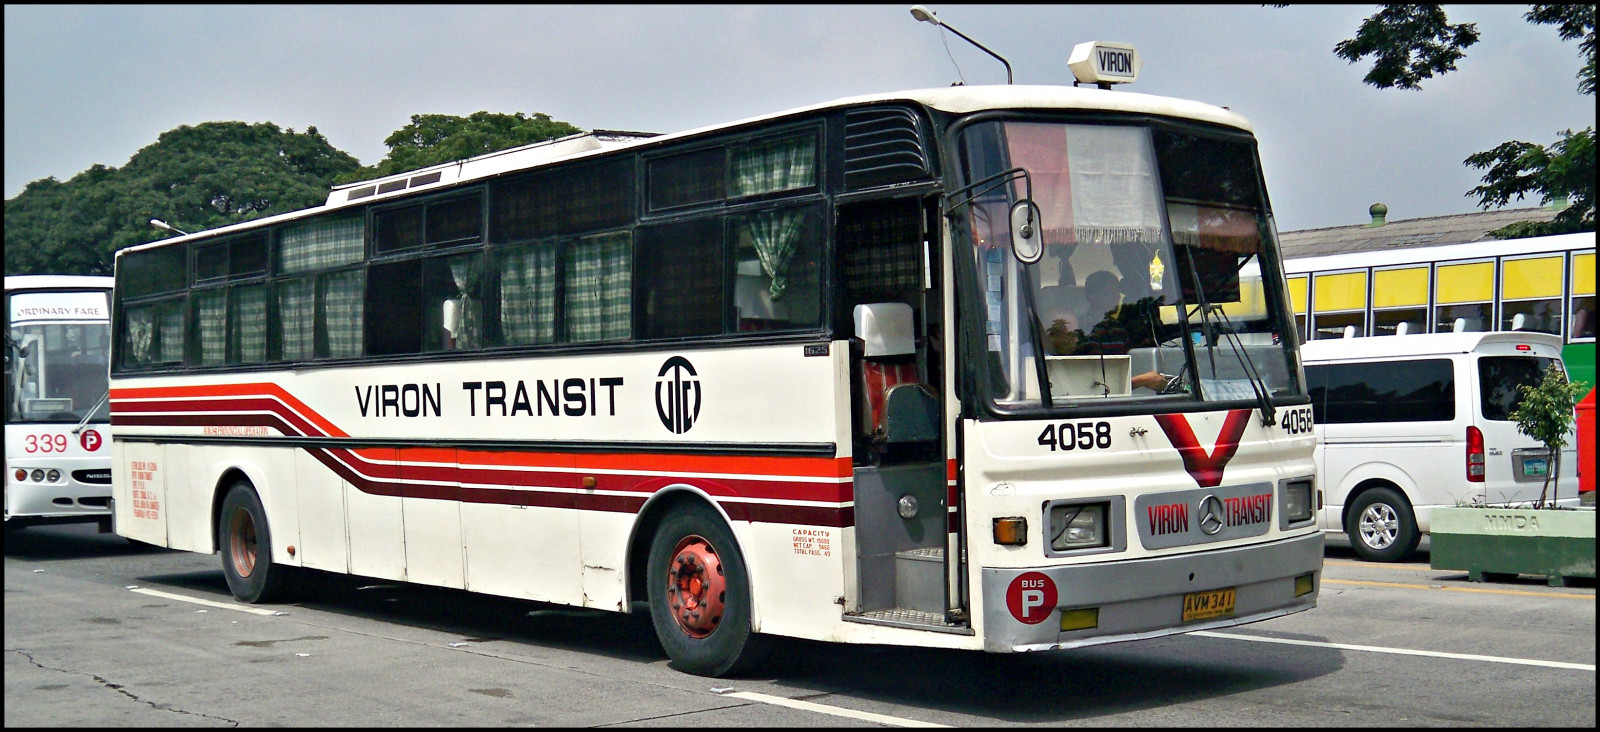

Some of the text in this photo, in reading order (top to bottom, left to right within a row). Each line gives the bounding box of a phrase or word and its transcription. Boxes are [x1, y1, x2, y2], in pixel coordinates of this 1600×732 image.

[1098, 50, 1132, 73] VIRON
[17, 307, 100, 317] ORDINARY FARE
[805, 346, 828, 355] 1625
[355, 376, 624, 418] VIRON TRANSIT
[1281, 408, 1313, 435] 4058
[25, 433, 68, 454] 339
[85, 435, 98, 450] P
[1038, 421, 1112, 452] 4058
[1147, 493, 1273, 536] VIRON TRANSIT
[1484, 514, 1540, 531] MMDA
[792, 529, 830, 537] CAPACITY
[1021, 579, 1045, 588] BUS
[1021, 589, 1045, 618] P
